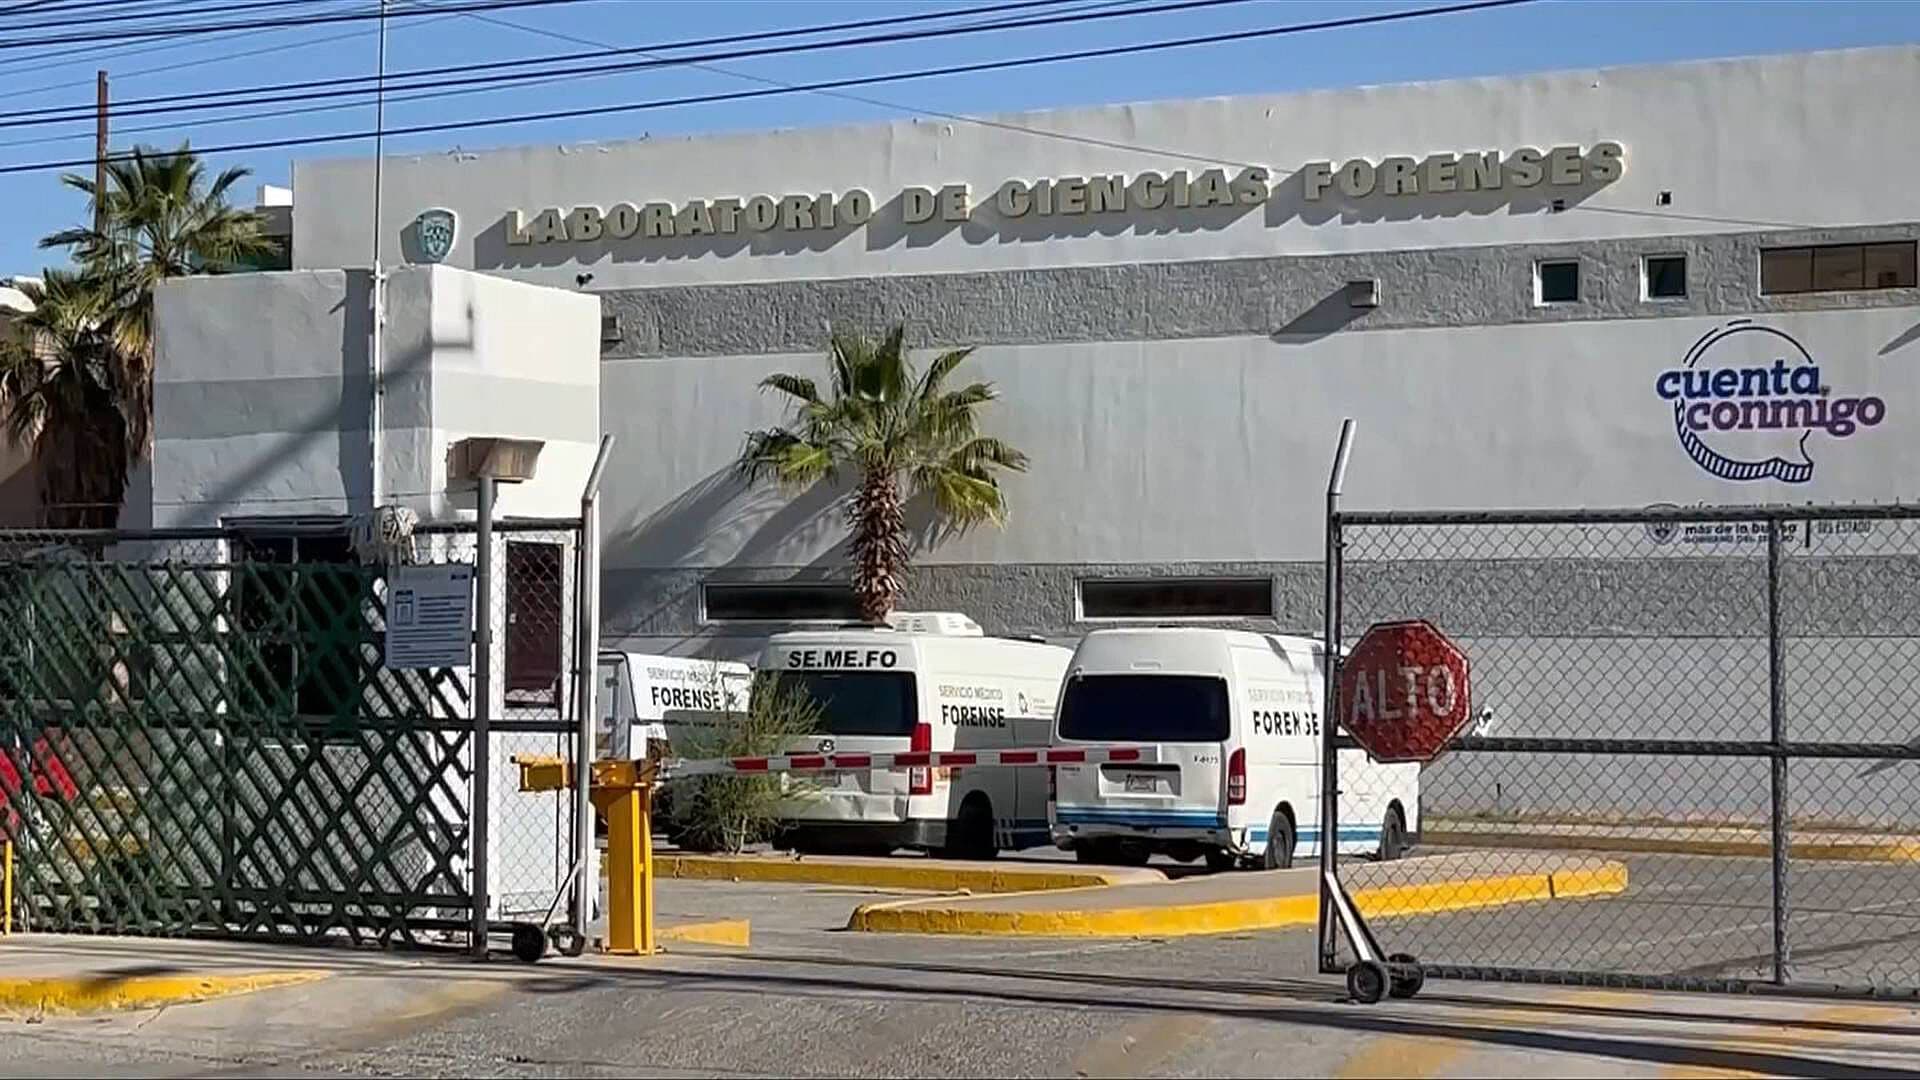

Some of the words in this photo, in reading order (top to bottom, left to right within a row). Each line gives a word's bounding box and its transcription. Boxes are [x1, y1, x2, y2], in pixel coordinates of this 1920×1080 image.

[506, 189, 873, 245] LABORATORIO
[903, 182, 971, 222] DE
[1000, 166, 1270, 217] CIENCIAS
[1304, 141, 1628, 200] FORENSES
[1656, 360, 1820, 399] cuenta
[1687, 397, 1885, 437] conmigo
[788, 650, 897, 668] SE.ME.FO
[651, 686, 721, 710] FORENSE
[1350, 664, 1455, 724] ALTO
[941, 704, 1006, 728] FORENSE
[1253, 710, 1320, 736] FORENSE
